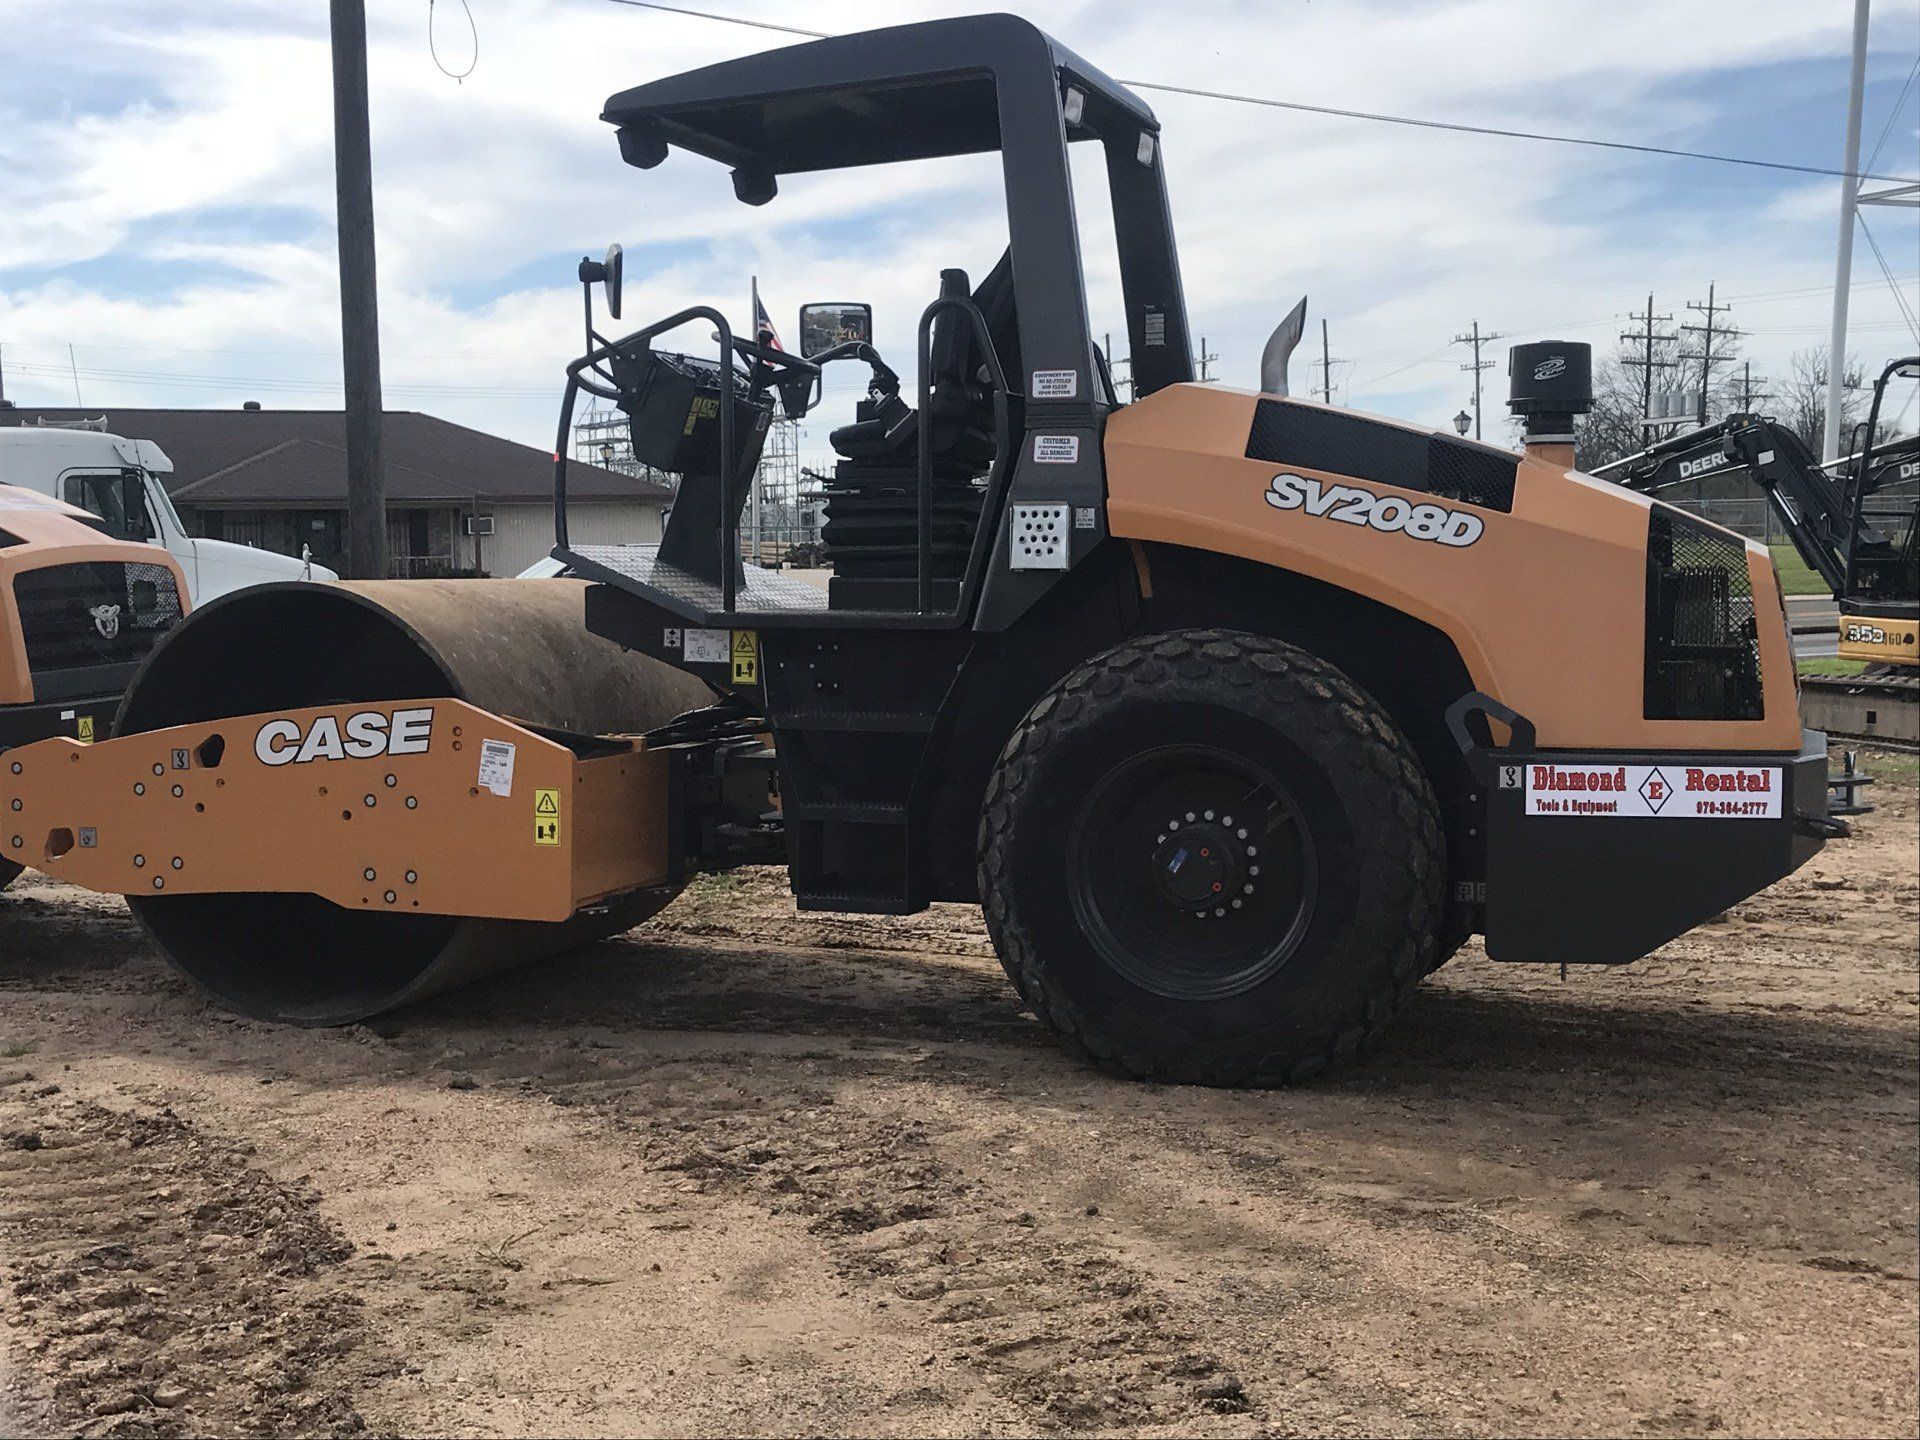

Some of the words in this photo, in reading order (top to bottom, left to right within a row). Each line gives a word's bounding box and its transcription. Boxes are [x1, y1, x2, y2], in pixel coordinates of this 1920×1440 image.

[1265, 473, 1484, 547] SV208D
[254, 707, 434, 766] CASE
[1533, 766, 1626, 791] Diamond
[1649, 782, 1663, 799] E
[1686, 768, 1770, 792] Rental
[1536, 799, 1559, 812] Tools
[1562, 799, 1568, 812] &
[1572, 799, 1617, 814] Equipment
